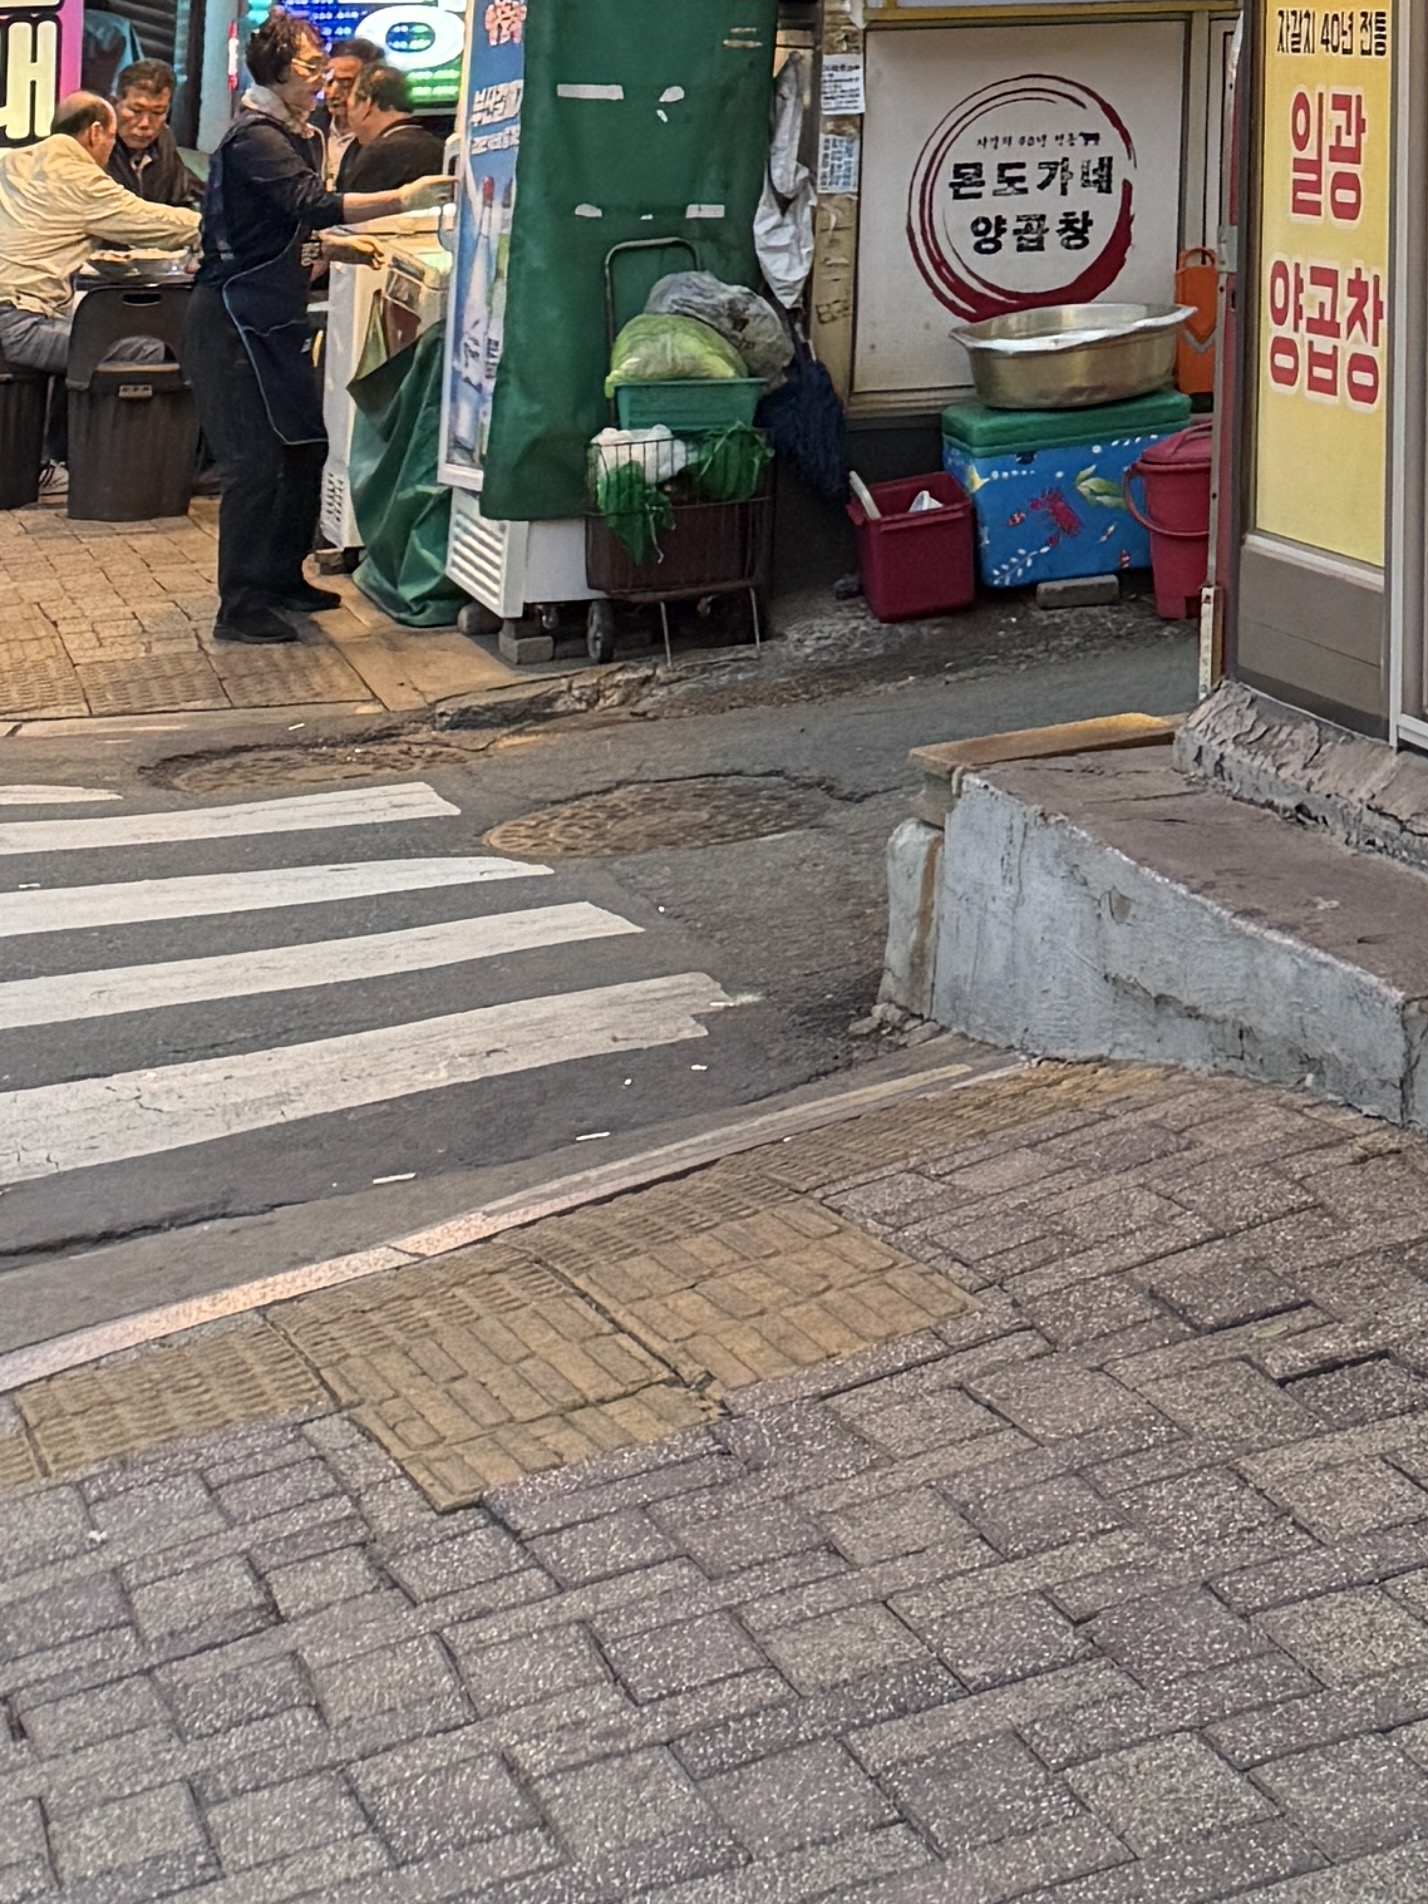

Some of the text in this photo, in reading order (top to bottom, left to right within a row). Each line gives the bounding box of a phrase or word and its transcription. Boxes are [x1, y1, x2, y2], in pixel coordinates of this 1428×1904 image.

[1276, 9, 1388, 58] 자갈치 40년 전통
[948, 155, 1114, 201] 몬도가네
[1291, 89, 1367, 222] 일광
[970, 210, 1094, 255] 양곱창
[1269, 258, 1385, 406] 양곱창
